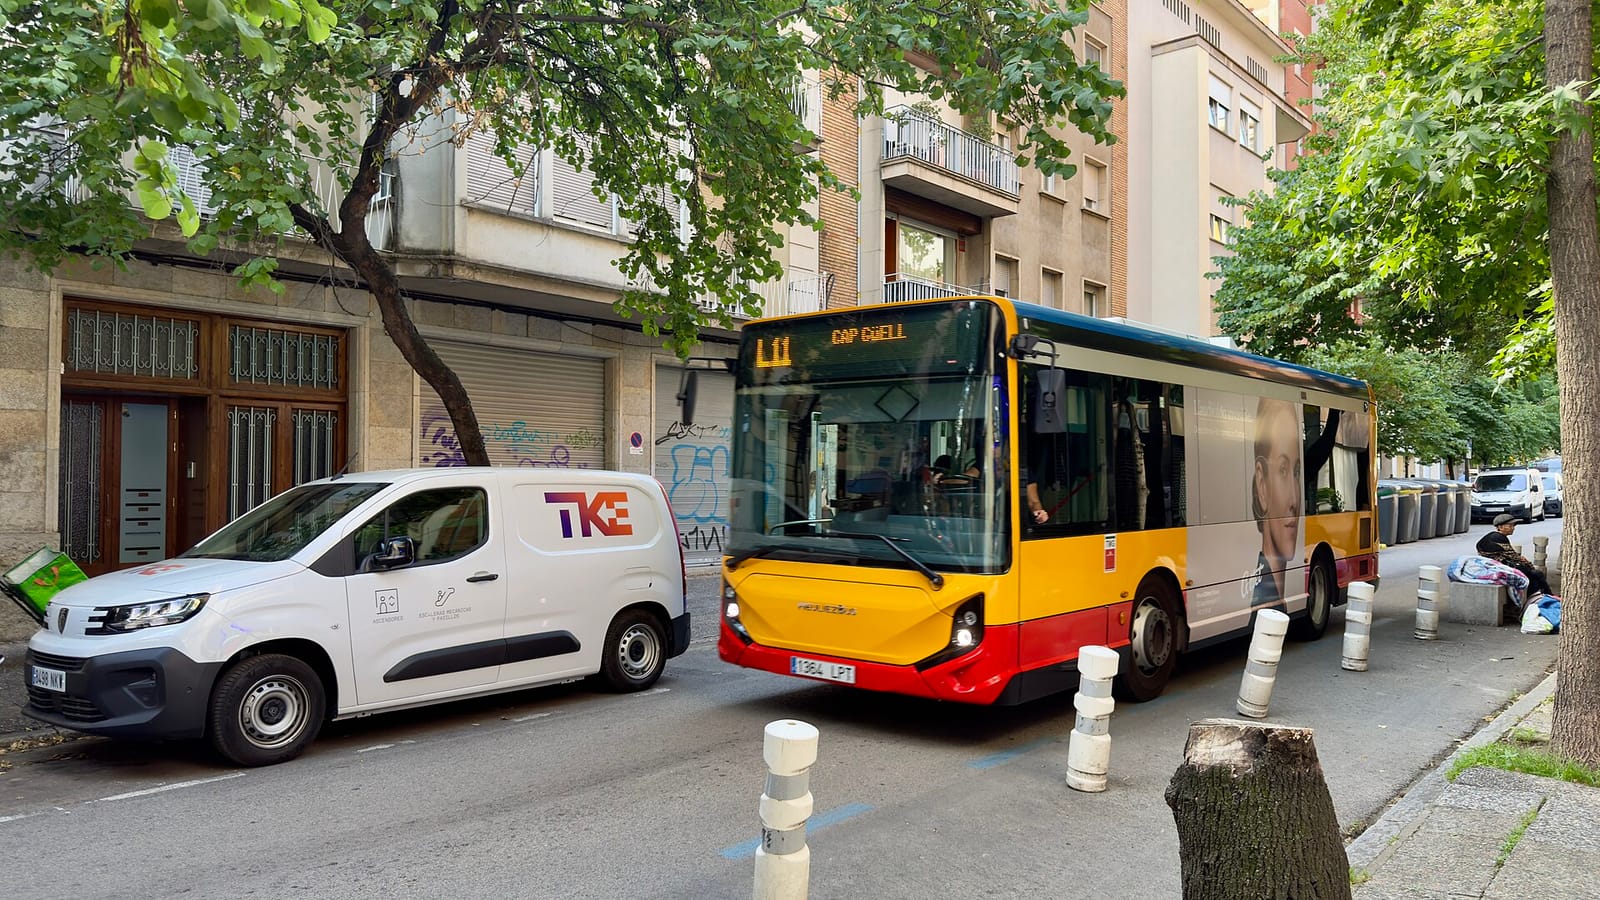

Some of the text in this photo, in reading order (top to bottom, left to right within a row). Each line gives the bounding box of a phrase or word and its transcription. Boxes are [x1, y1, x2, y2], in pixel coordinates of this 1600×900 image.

[831, 324, 907, 345] CAP GÜELL
[756, 336, 792, 368] L11
[544, 492, 633, 538] TKE
[372, 616, 404, 624] ASCENSORES
